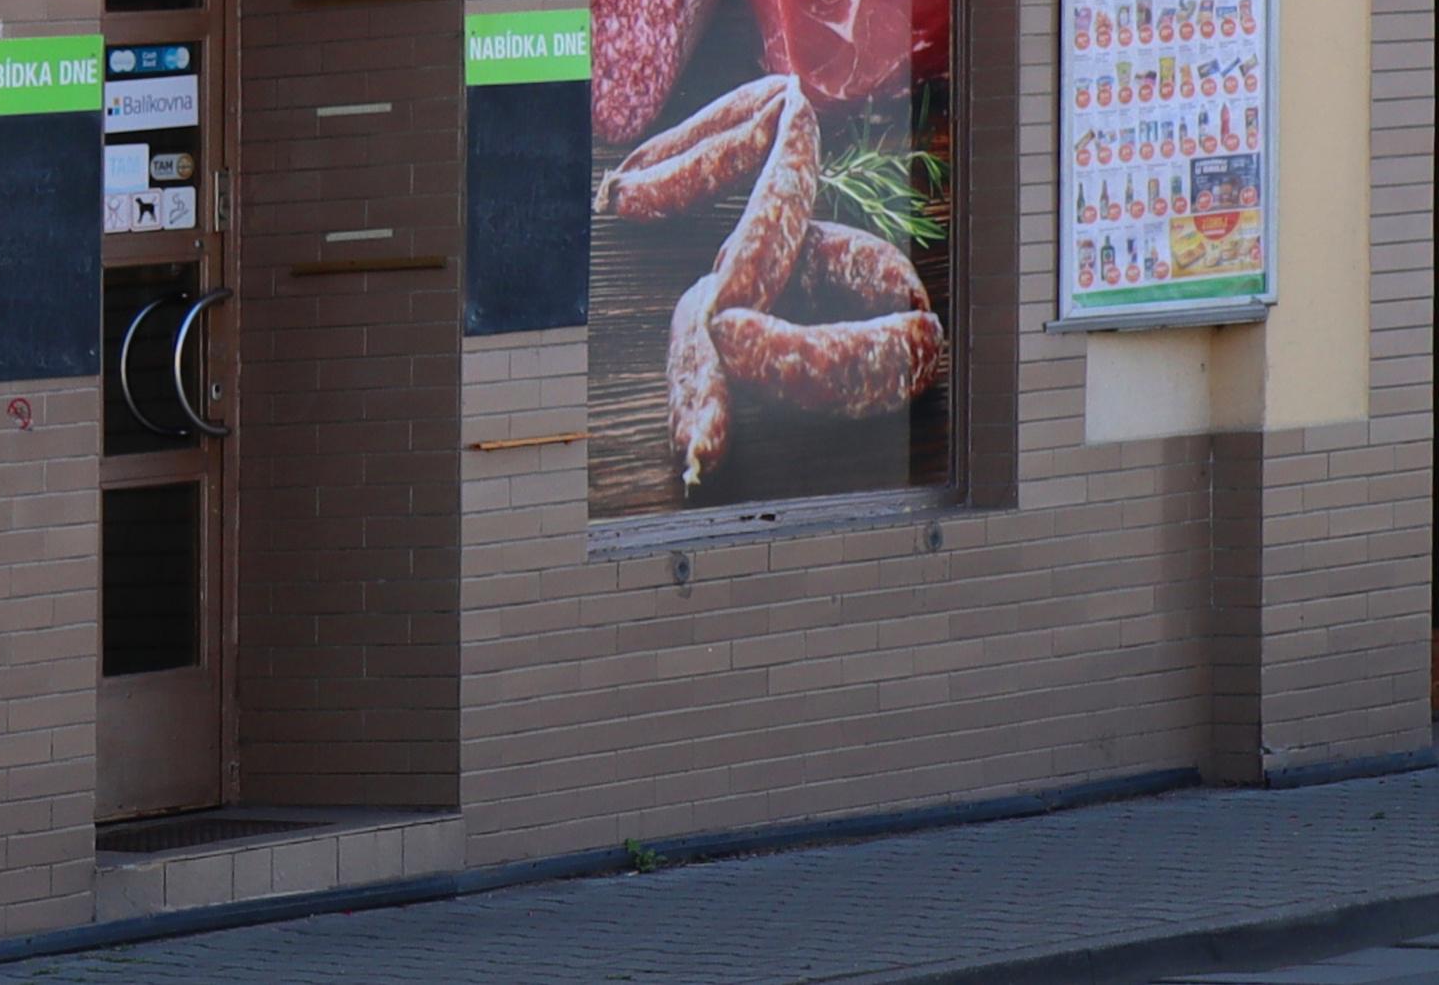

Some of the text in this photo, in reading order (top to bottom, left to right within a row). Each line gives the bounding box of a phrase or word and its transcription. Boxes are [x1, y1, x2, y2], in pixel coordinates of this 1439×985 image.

[469, 30, 587, 61] NABÍDKA DNE
[60, 58, 98, 85] DNE
[123, 94, 193, 115] Balíkovna
